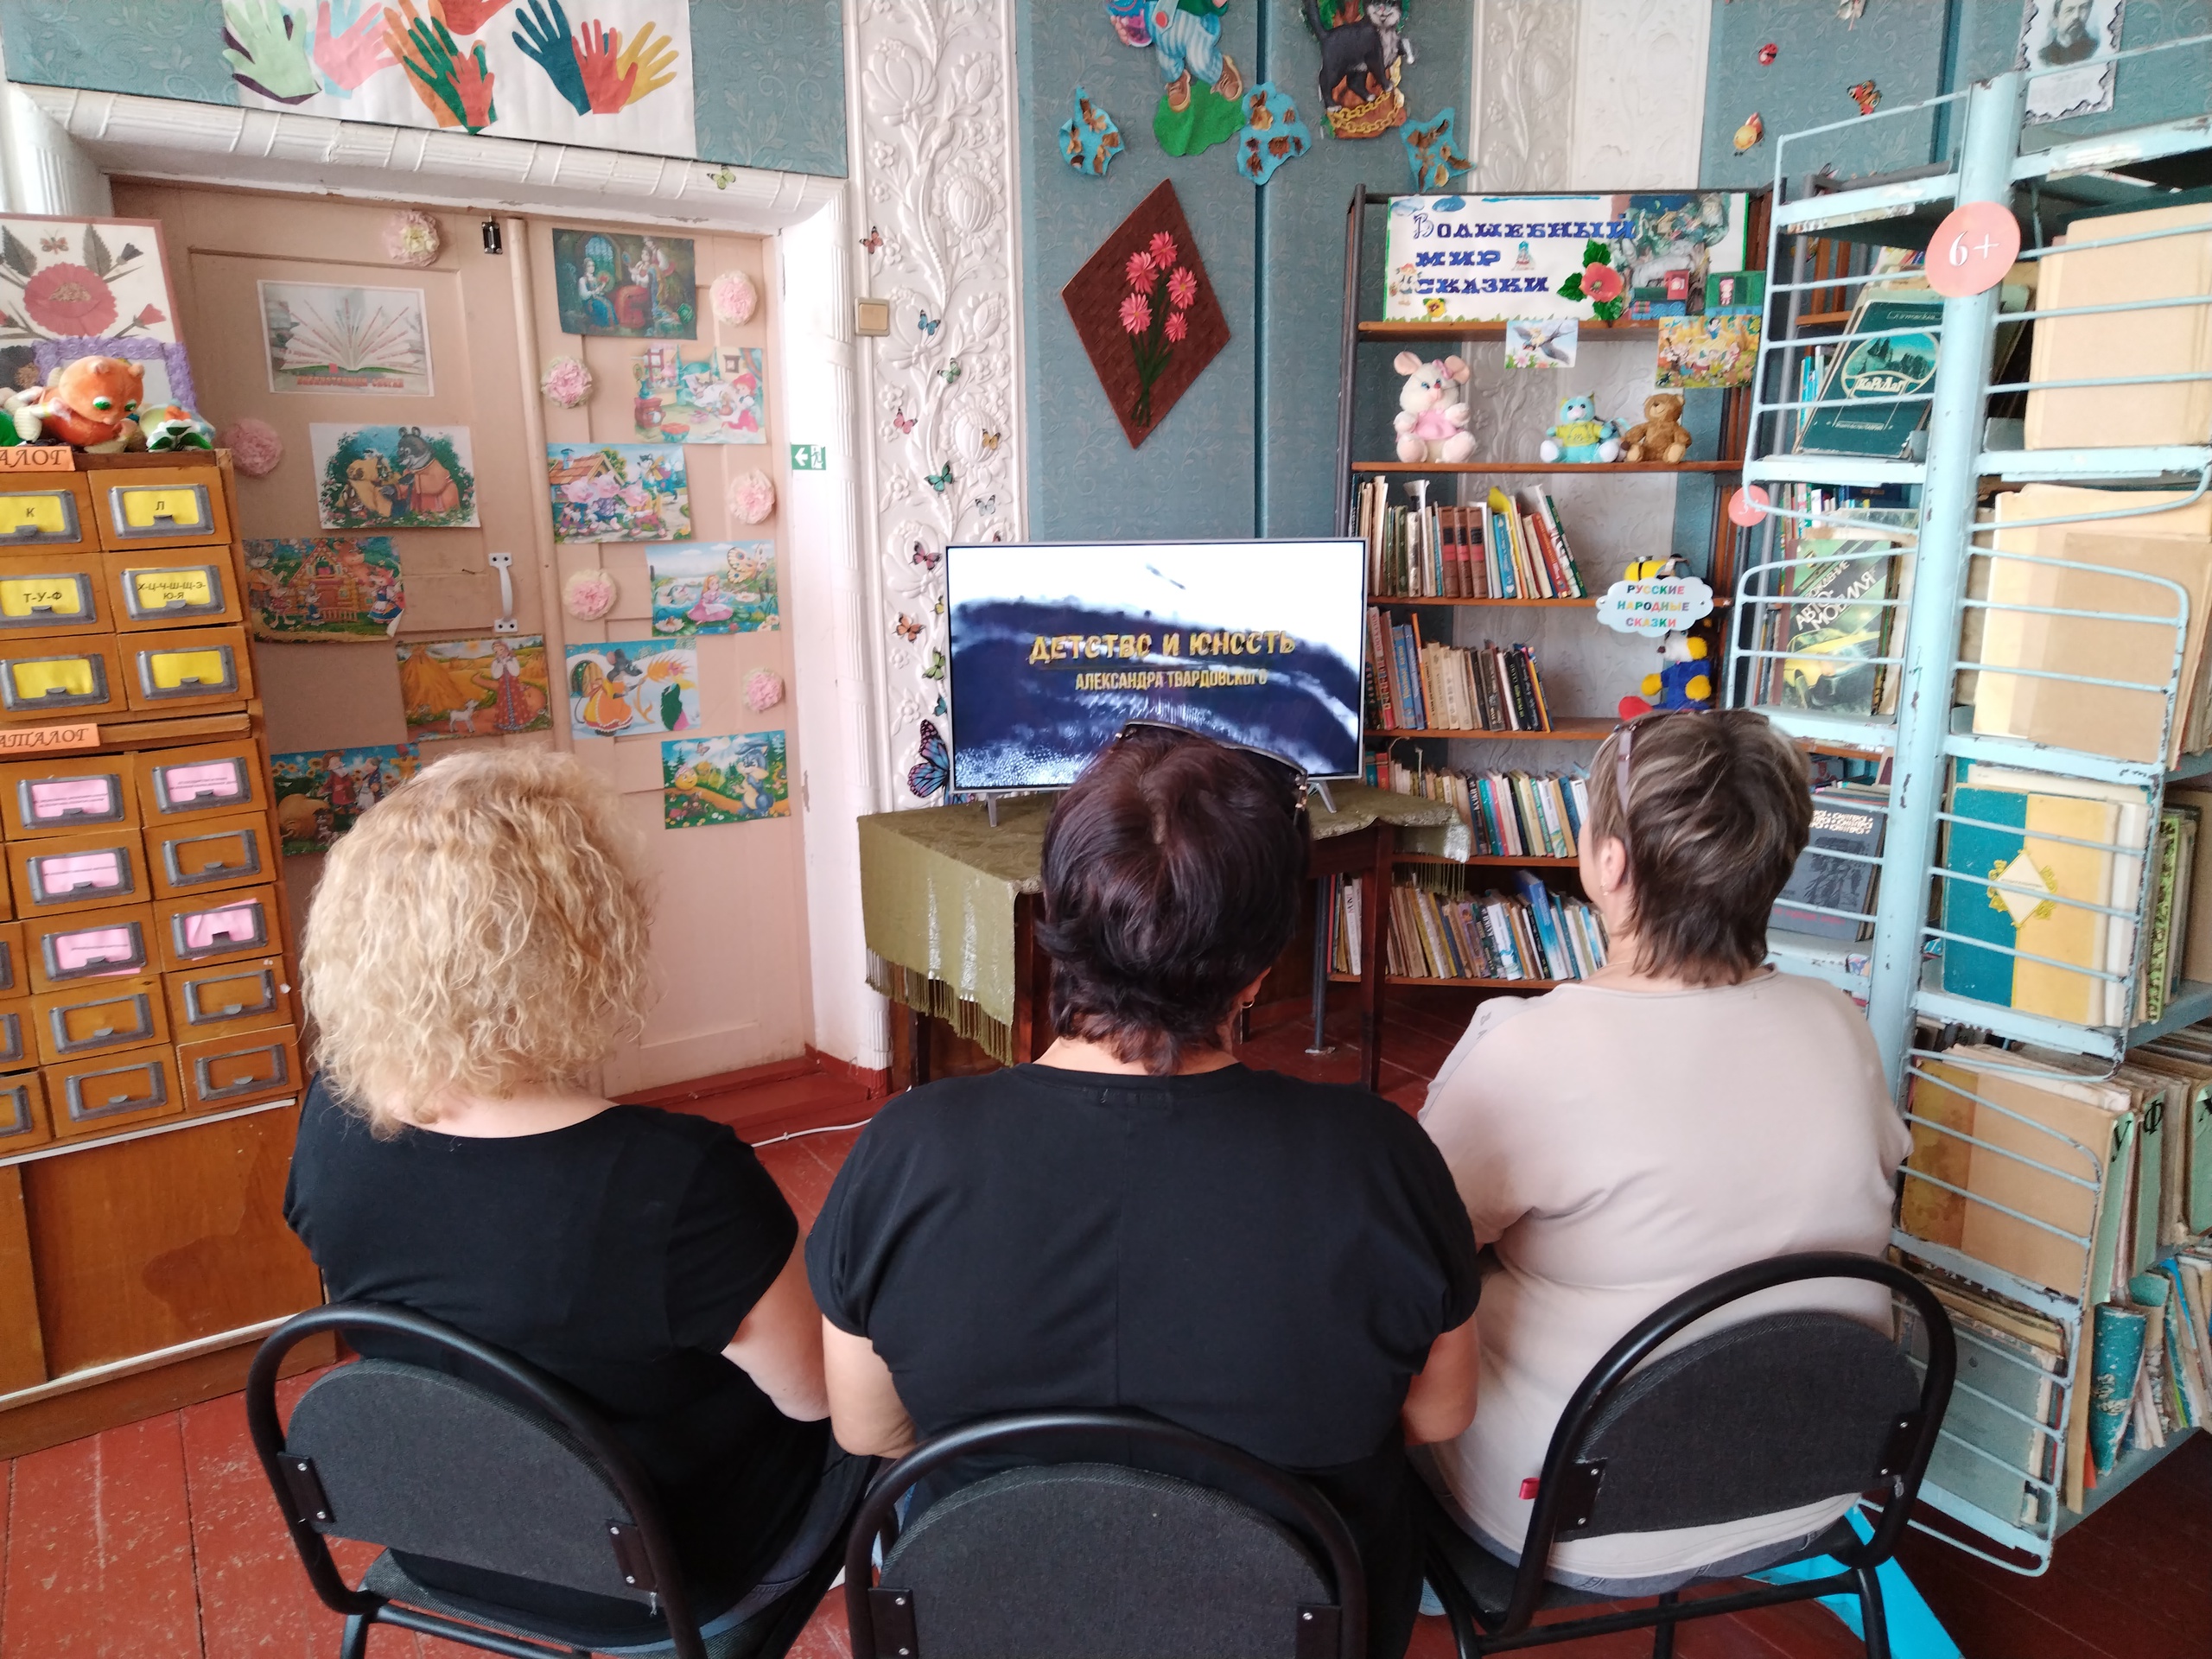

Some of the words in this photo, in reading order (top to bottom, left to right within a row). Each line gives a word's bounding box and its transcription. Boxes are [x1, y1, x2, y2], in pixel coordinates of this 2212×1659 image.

[1949, 231, 1999, 267] 6+
[1415, 250, 1501, 268] МИР
[1415, 276, 1549, 296] СКАЗКИ
[26, 507, 35, 518] К
[156, 500, 165, 511] Л
[23, 591, 62, 603] Т-У-Ф
[1626, 584, 1686, 595] РУССКИЕ
[1617, 600, 1690, 613] НАРОДНЫЕ
[1625, 618, 1676, 628] СКАЗКИ
[1028, 632, 1153, 665] ДЕТСТВО
[1162, 632, 1180, 657] И
[1189, 630, 1296, 657] ЮНОСТЬ
[1075, 671, 1164, 690] АЛЕКСАНДРА
[1166, 668, 1268, 689] ТВАРДОВСКОГО
[2143, 1098, 2165, 1135] Ф
